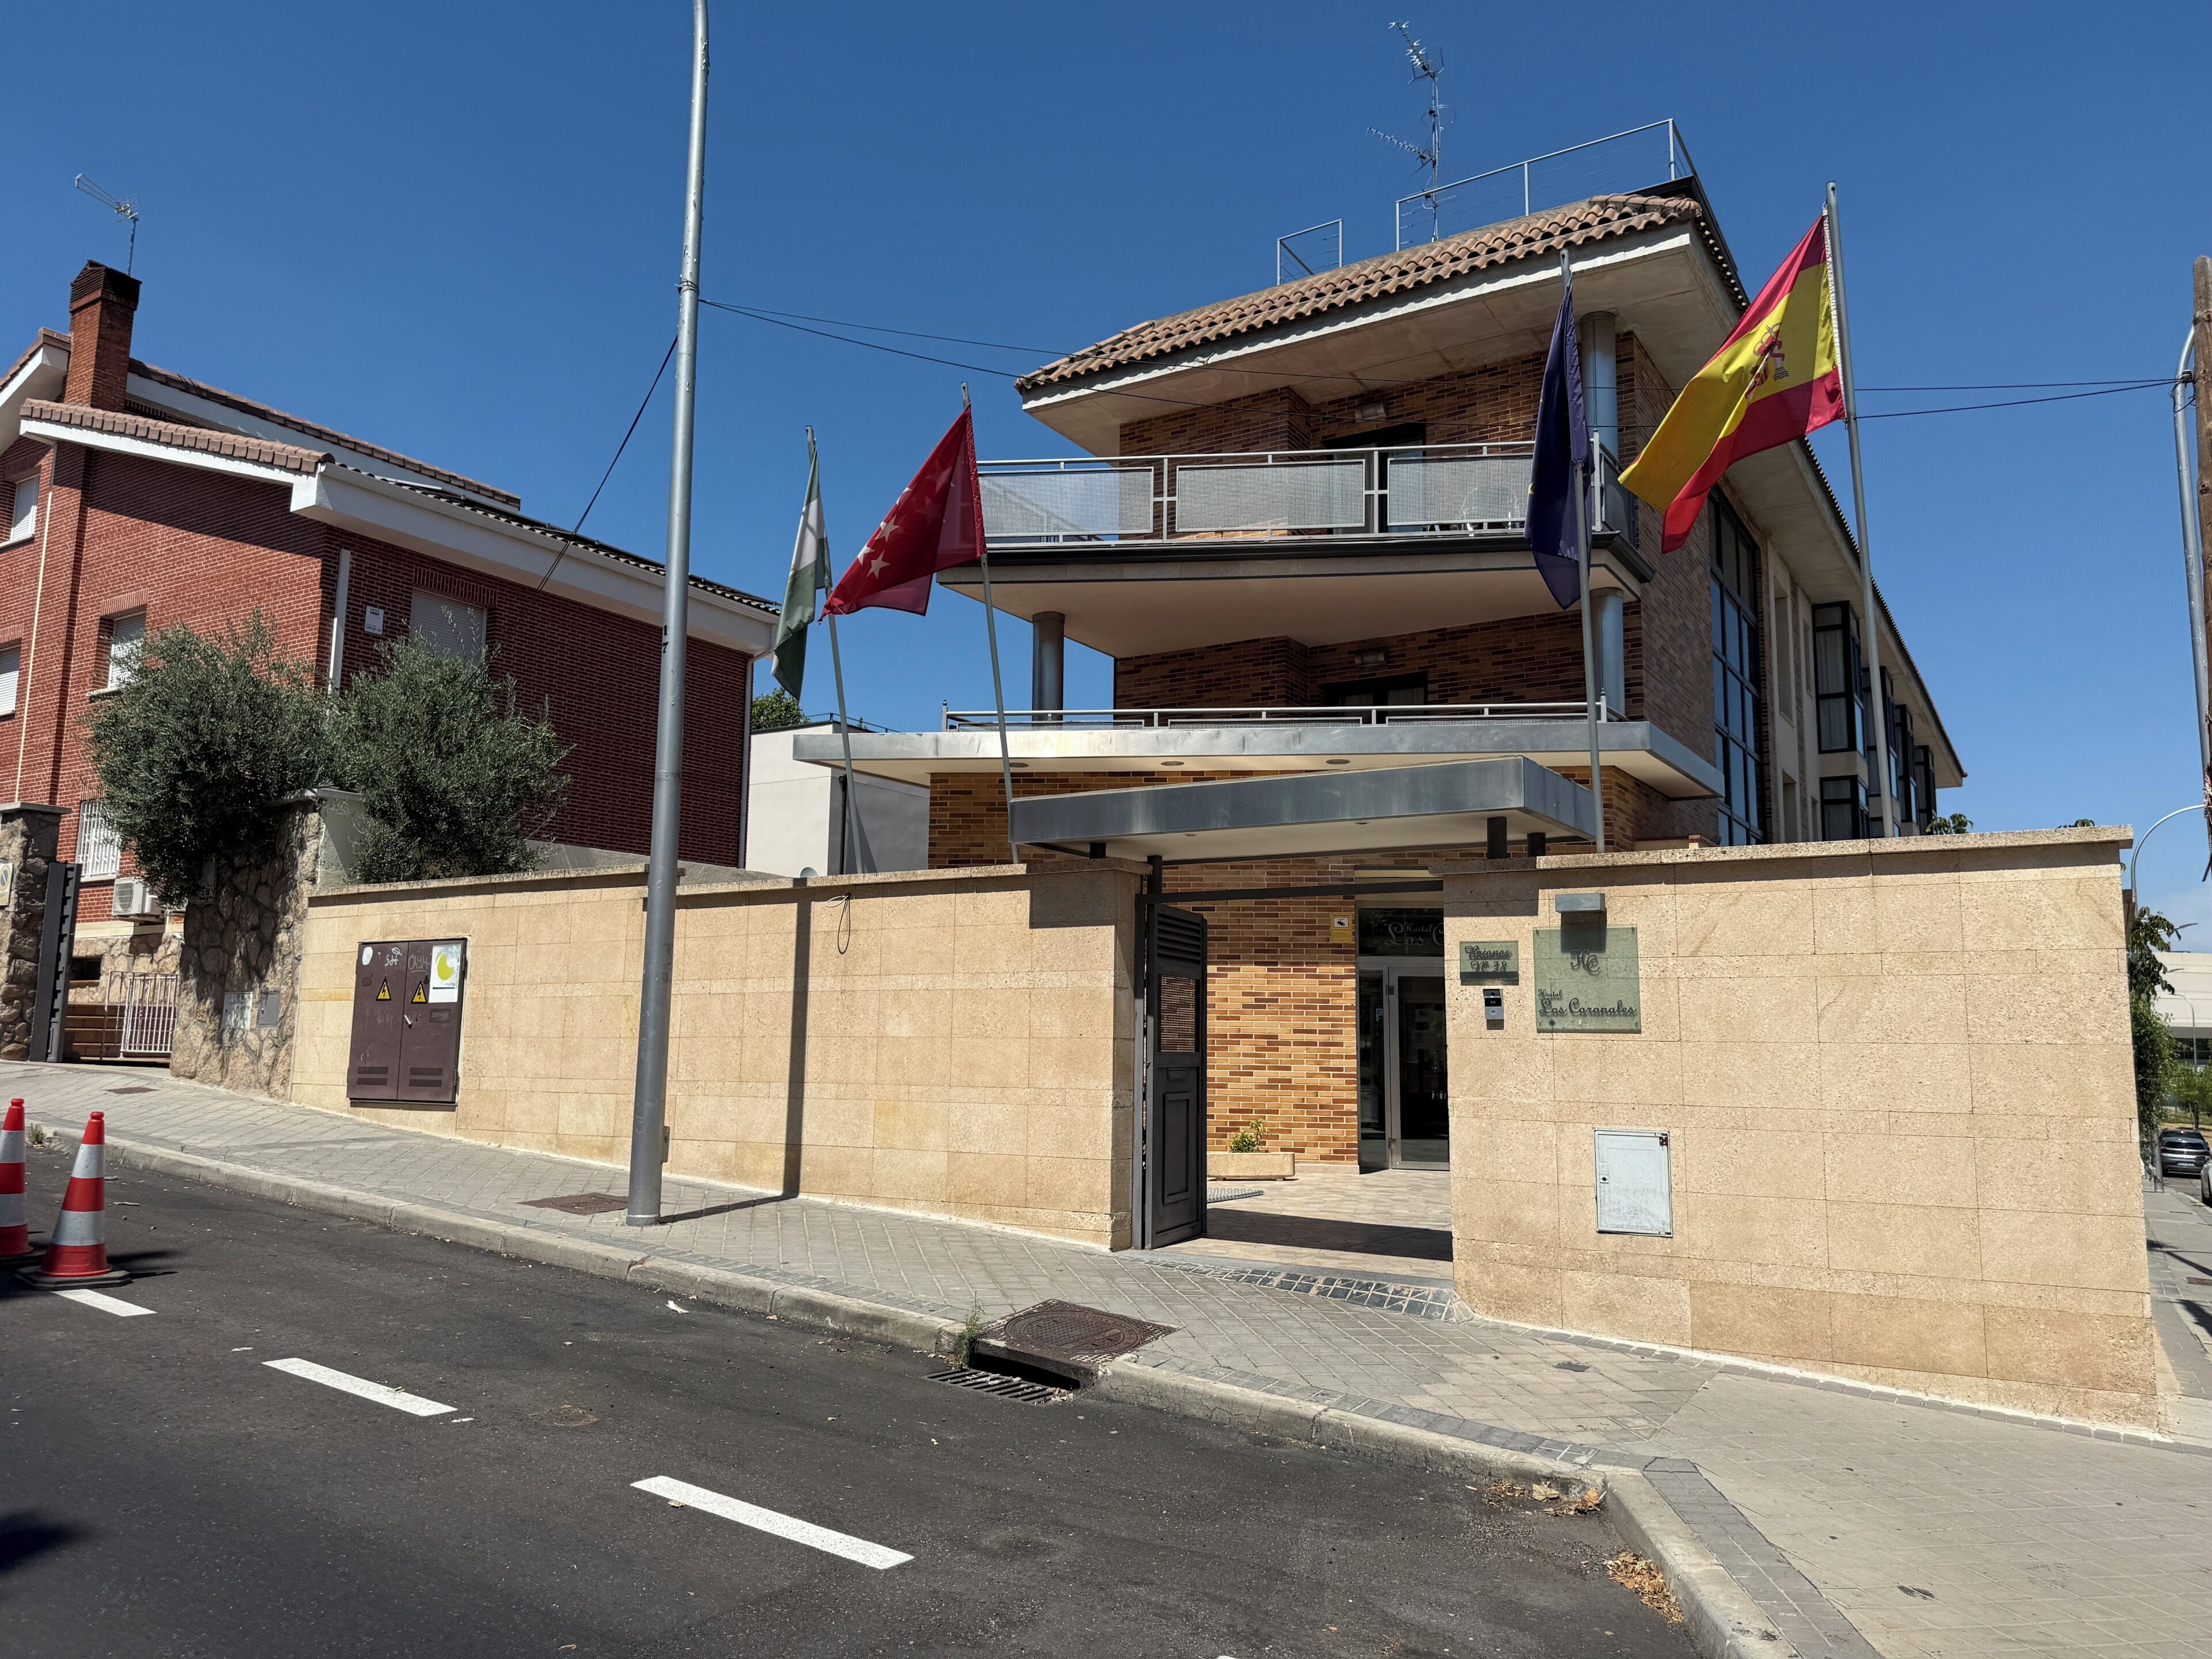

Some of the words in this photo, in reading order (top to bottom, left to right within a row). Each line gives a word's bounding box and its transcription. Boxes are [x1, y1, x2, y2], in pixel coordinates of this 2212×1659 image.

[1404, 922, 1433, 933] Hostal
[1384, 922, 1429, 946] Los
[1493, 960, 1508, 972] 38
[1537, 988, 1562, 997] Hostal
[1539, 998, 1567, 1014] Los
[1569, 997, 1637, 1014] Coronales
